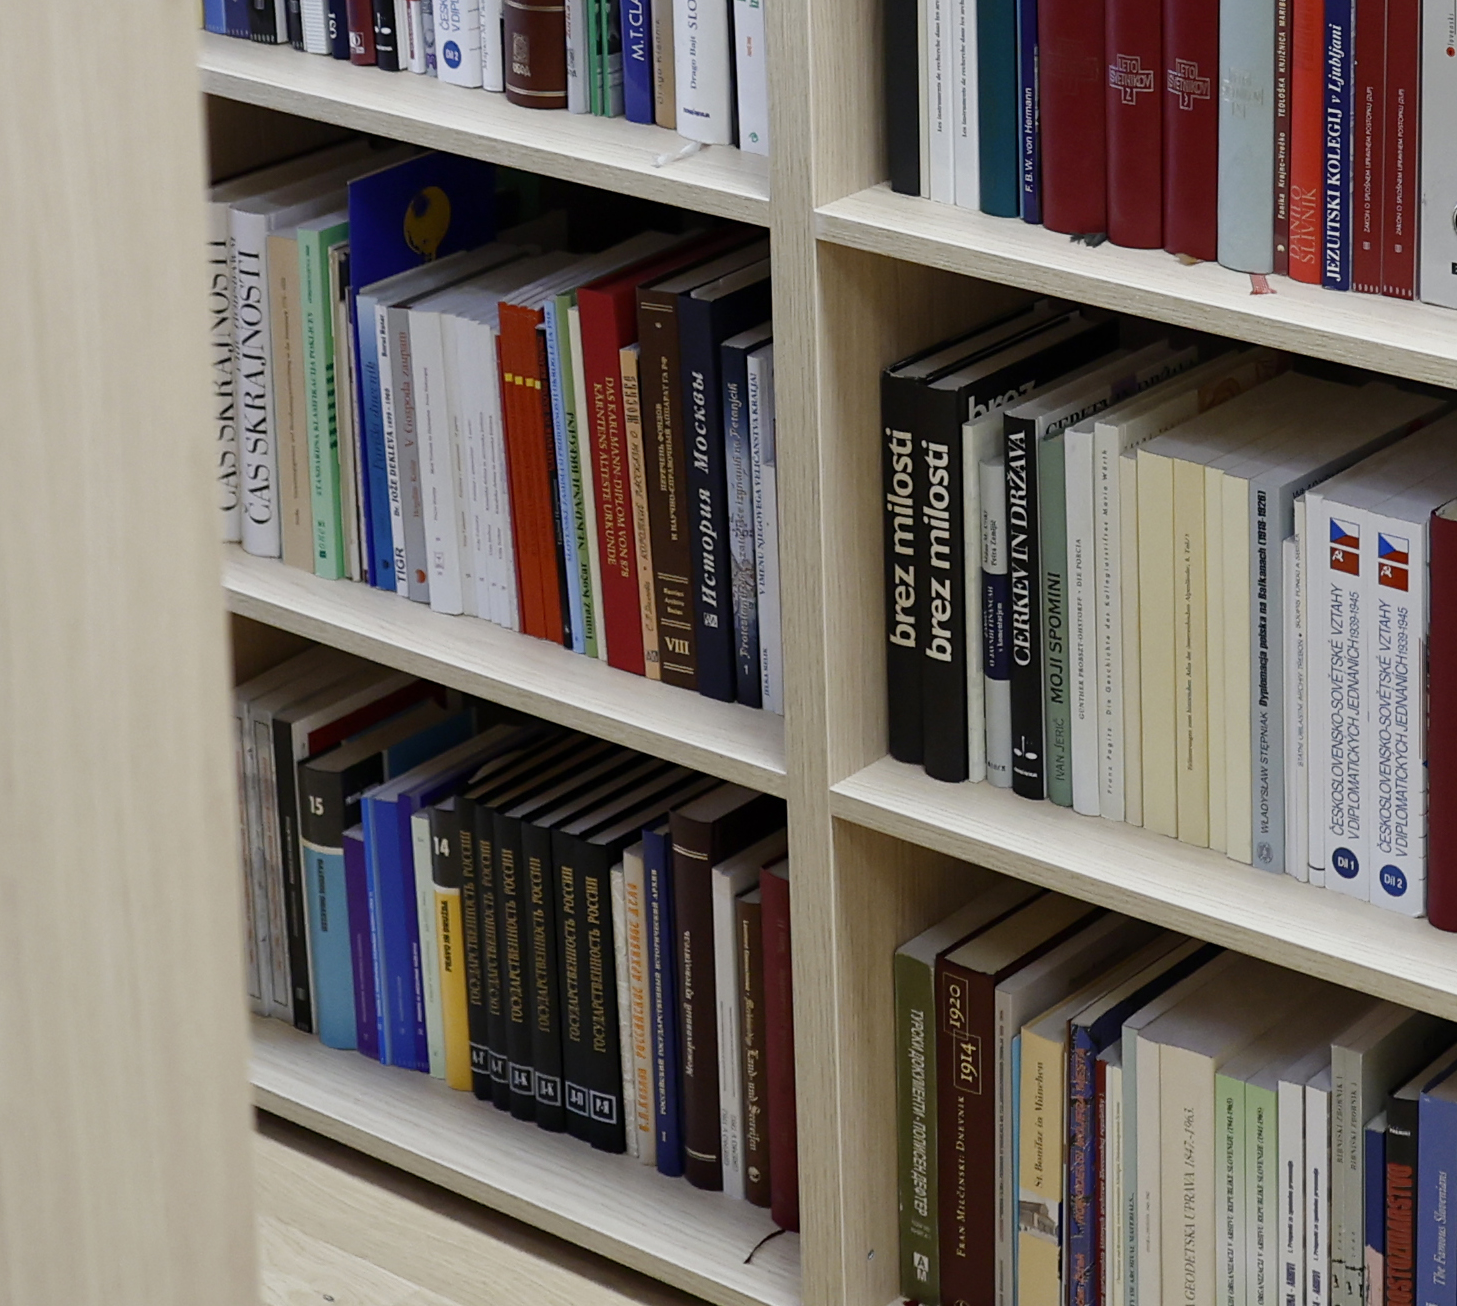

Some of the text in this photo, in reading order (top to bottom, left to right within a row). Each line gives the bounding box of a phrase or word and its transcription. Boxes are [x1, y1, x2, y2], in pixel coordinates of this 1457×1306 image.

[689, 36, 698, 57] Bajt
[690, 60, 698, 89] Drago
[1277, 32, 1285, 72] KNJIŽNICA
[1328, 23, 1342, 92] Ljubljani
[1277, 78, 1285, 116] TEOLOŠKA
[1327, 106, 1342, 186] KOLEGIJ
[1302, 188, 1316, 263] SLIVNIK
[1326, 190, 1341, 281] JEZUITSKI
[238, 249, 273, 524] ČAS SKRAJNOSTI
[605, 378, 629, 577] DAS KARLMANN-DIPLOM VON 878
[692, 371, 717, 607] История Москвы
[394, 547, 406, 583] TIGR
[886, 428, 916, 648] brez milosti
[1006, 430, 1031, 666] CERKEV IN DRŽAVA
[664, 636, 690, 655] VIII
[1328, 583, 1344, 836] ČESKOSLOVENSKO-SOVĚTSKÉ VZTAHY
[1344, 591, 1360, 839] V DIPLOMATICKÝCH JEDNÁNÍCH 1939-1945
[309, 796, 324, 816] 15
[433, 836, 450, 857] 14
[1397, 879, 1403, 889] 2
[529, 858, 551, 1032] ГОСУДАРСТВЕННОСТЬ РОССИИ
[948, 984, 963, 1028] 1920
[961, 1041, 977, 1083] 1914
